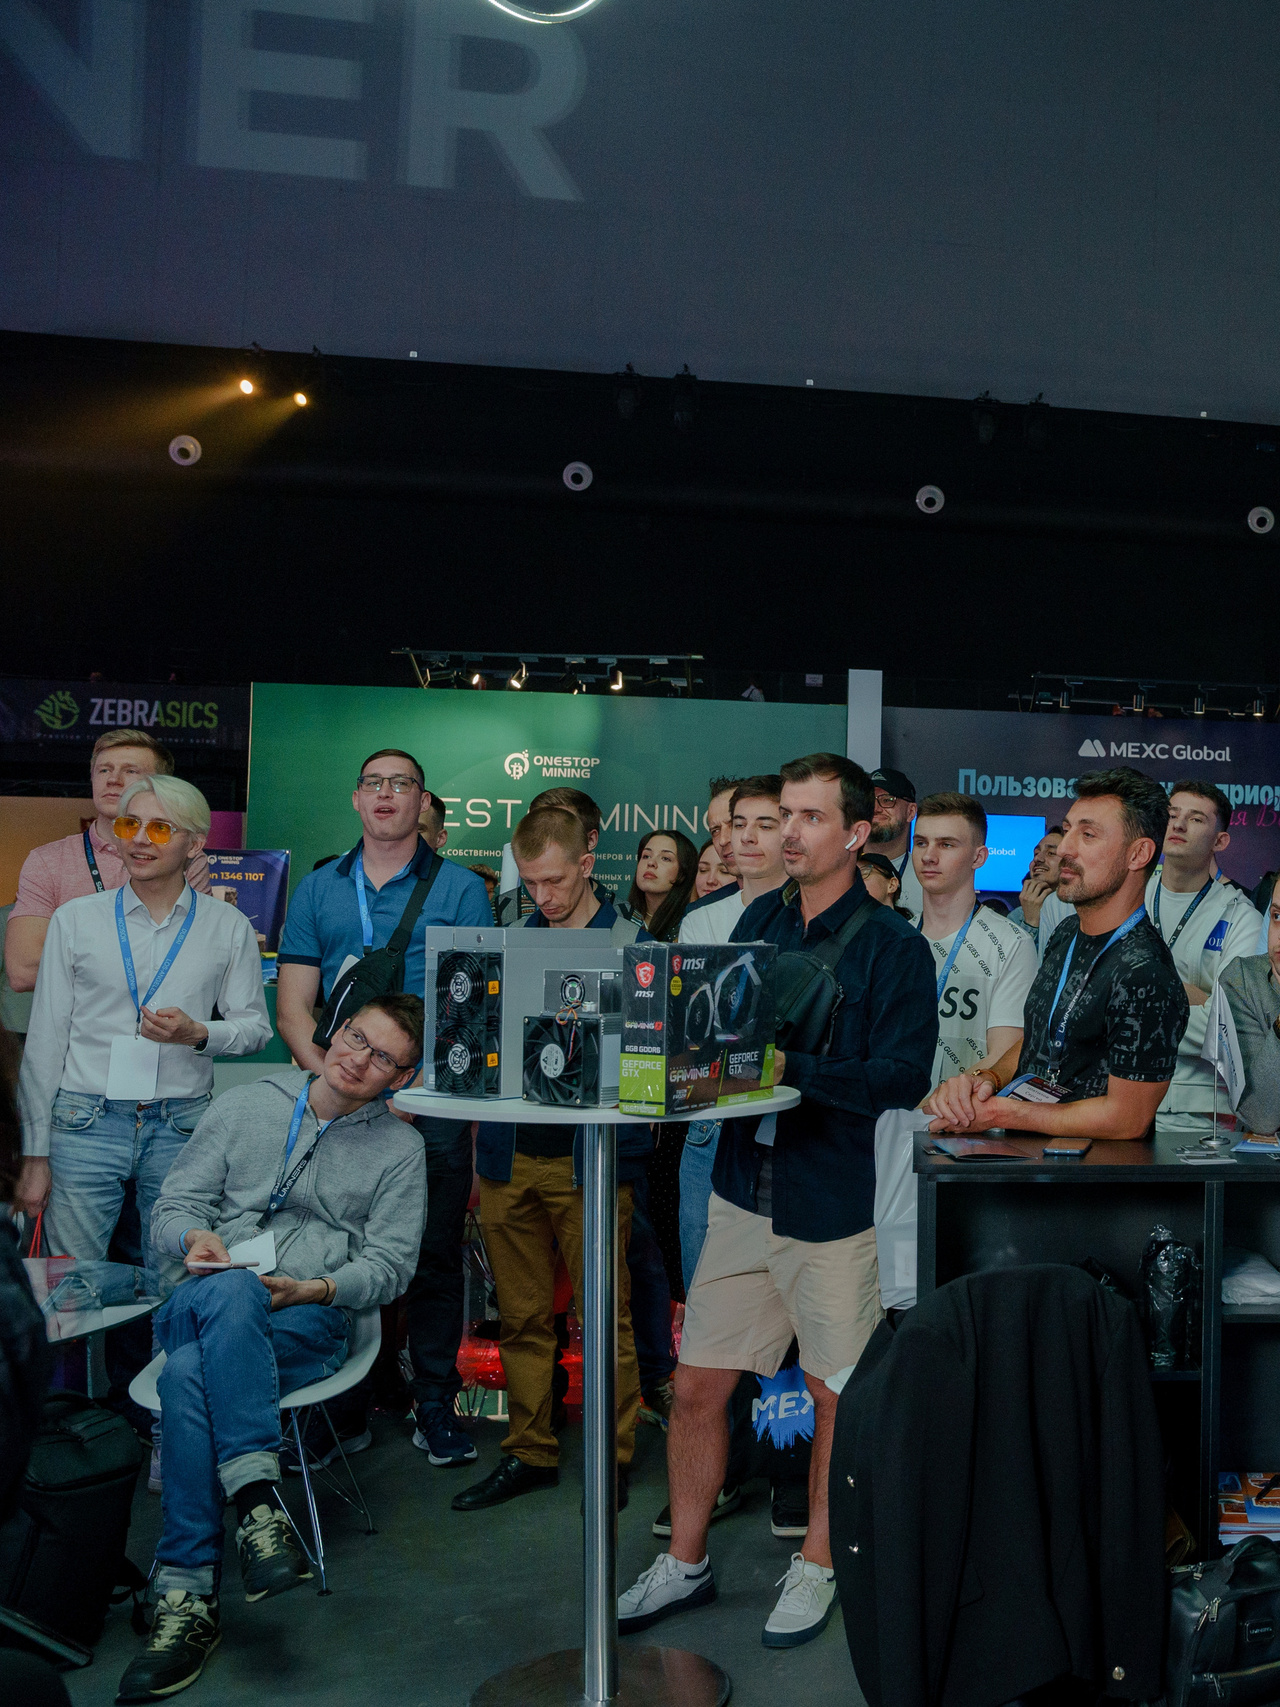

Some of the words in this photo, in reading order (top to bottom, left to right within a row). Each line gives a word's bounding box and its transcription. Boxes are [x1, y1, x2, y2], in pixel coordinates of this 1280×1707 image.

[88, 698, 219, 729] ZEBRASICS
[1110, 742, 1169, 760] MEXC
[1172, 744, 1232, 762] Global
[533, 755, 600, 768] ONESTOP
[542, 767, 591, 779] MINING
[221, 872, 243, 880] 1346
[245, 873, 265, 881] 110T
[175, 928, 187, 945] DUBAI
[933, 941, 949, 958] GUESS
[966, 943, 981, 959] GUESS
[978, 959, 993, 978] GUESS
[625, 1021, 655, 1030] GAMING
[625, 1045, 638, 1053] 6GB
[639, 1045, 661, 1053] GDDR6
[943, 1045, 961, 1065] GUESS
[729, 1051, 759, 1064] GEFORCE
[622, 1059, 662, 1070] GEFORCE
[728, 1064, 743, 1075] GTX
[622, 1068, 640, 1078] GTX
[669, 1066, 710, 1083] GAMING
